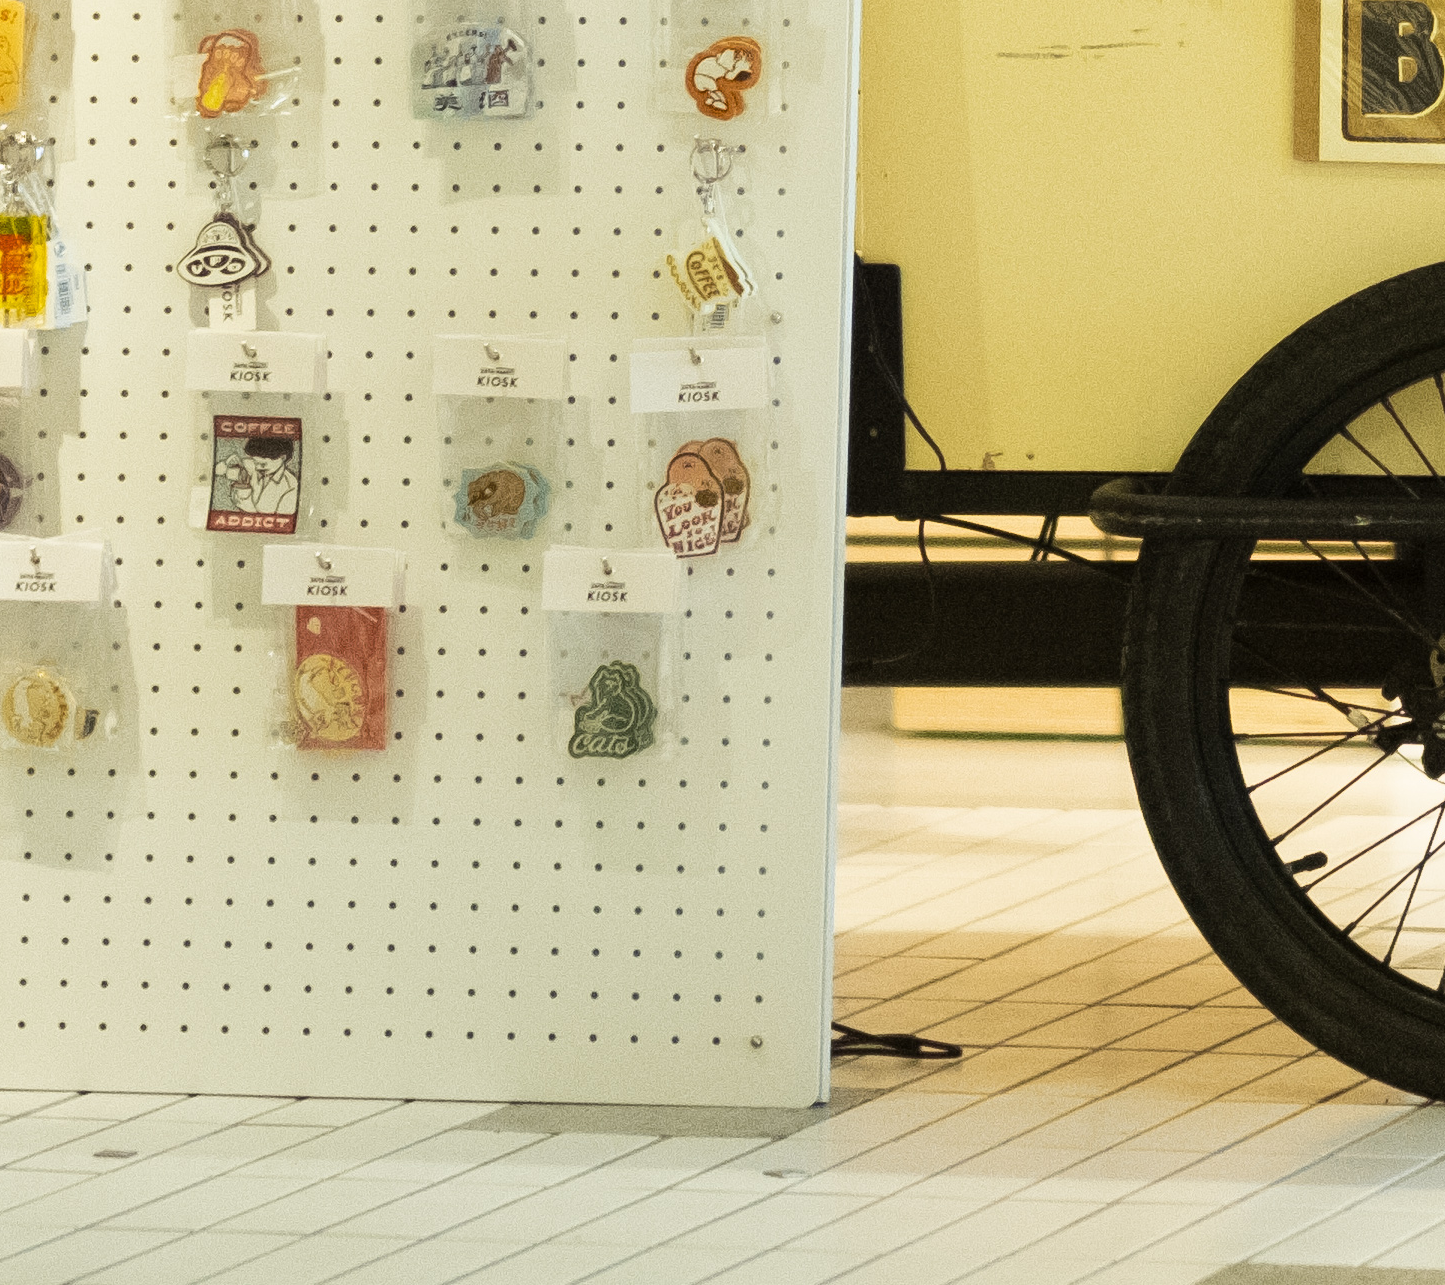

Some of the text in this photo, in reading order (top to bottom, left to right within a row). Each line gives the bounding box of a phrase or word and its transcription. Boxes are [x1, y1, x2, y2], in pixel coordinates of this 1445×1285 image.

[230, 370, 272, 383] KIOSK
[477, 375, 519, 388] KIOSK
[677, 391, 721, 404] KIOSK
[220, 421, 297, 435] COFFEE
[213, 515, 291, 529] ADDICT
[15, 580, 57, 594] KIOSK
[306, 584, 348, 598] KIOSK
[586, 590, 628, 603] KIOSK
